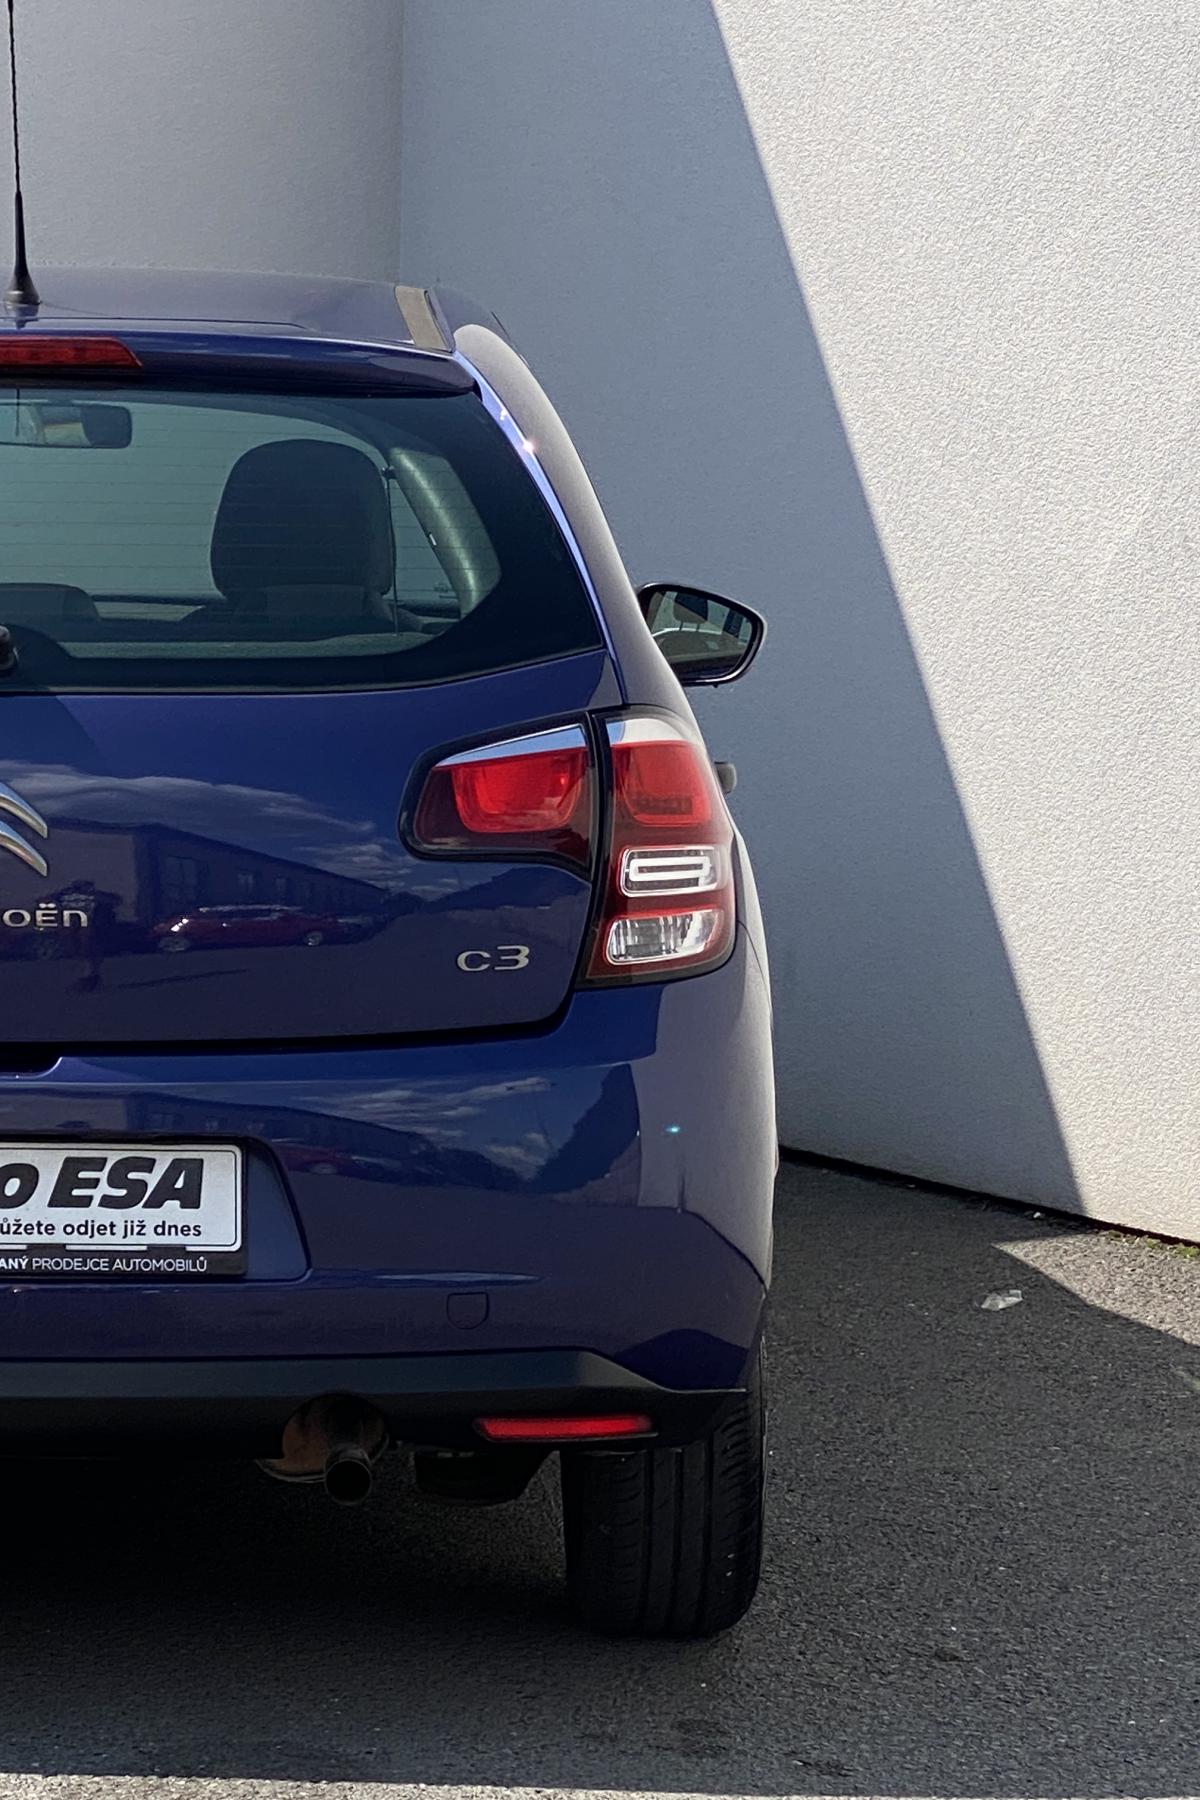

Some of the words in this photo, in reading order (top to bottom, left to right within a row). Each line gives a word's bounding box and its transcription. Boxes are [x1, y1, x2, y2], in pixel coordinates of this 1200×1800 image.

[47, 1157, 204, 1209] ESA
[63, 1220, 116, 1239] odjet
[122, 1220, 146, 1239] již
[153, 1220, 202, 1236] dnes
[31, 1257, 109, 1271] PRODEJCE
[111, 1255, 208, 1272] AUTOMOBILŮ
